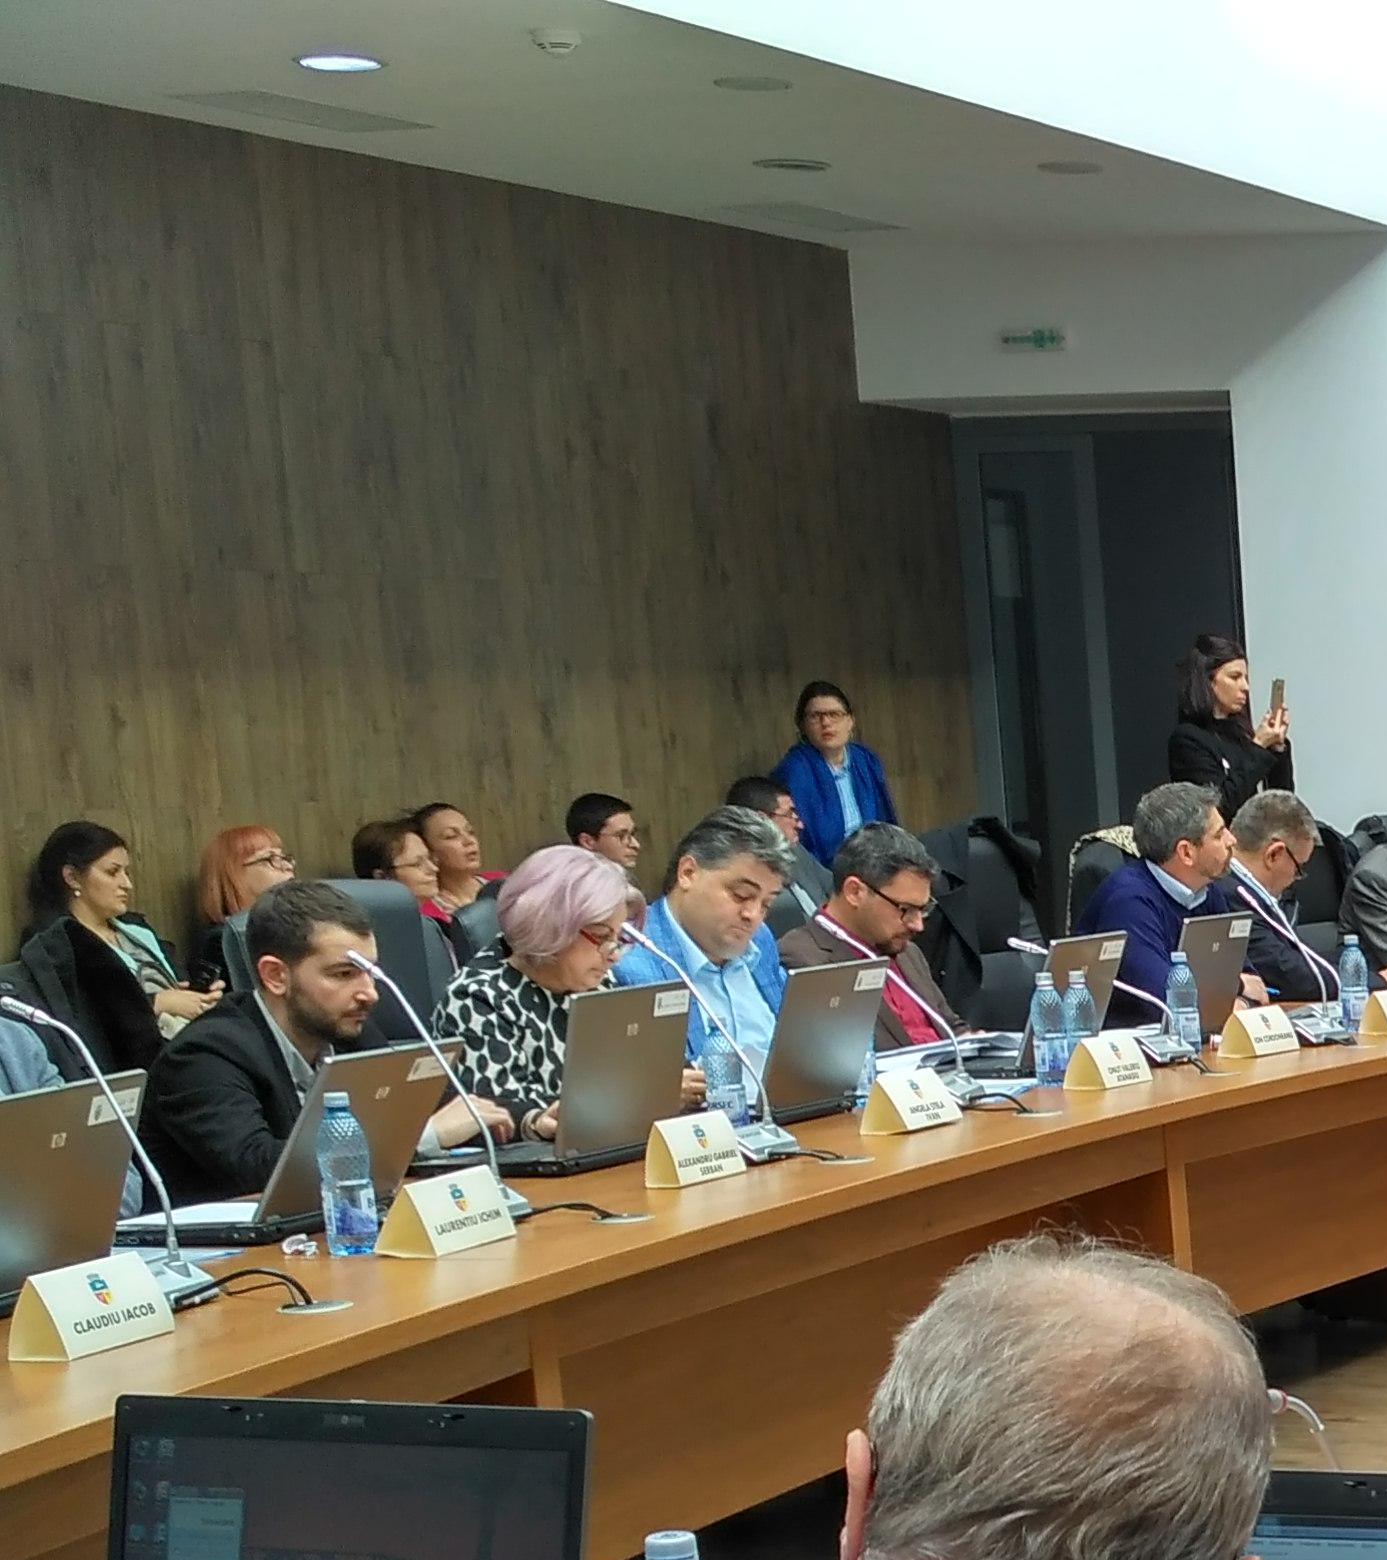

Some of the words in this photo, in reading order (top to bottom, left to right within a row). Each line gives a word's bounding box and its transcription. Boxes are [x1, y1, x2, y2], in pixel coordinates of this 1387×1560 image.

[677, 1154, 713, 1169] ALEXANDRU
[434, 1214, 478, 1236] LAURENTIU
[73, 1312, 121, 1335] CLAUDIU
[122, 1302, 157, 1323] IACOB
